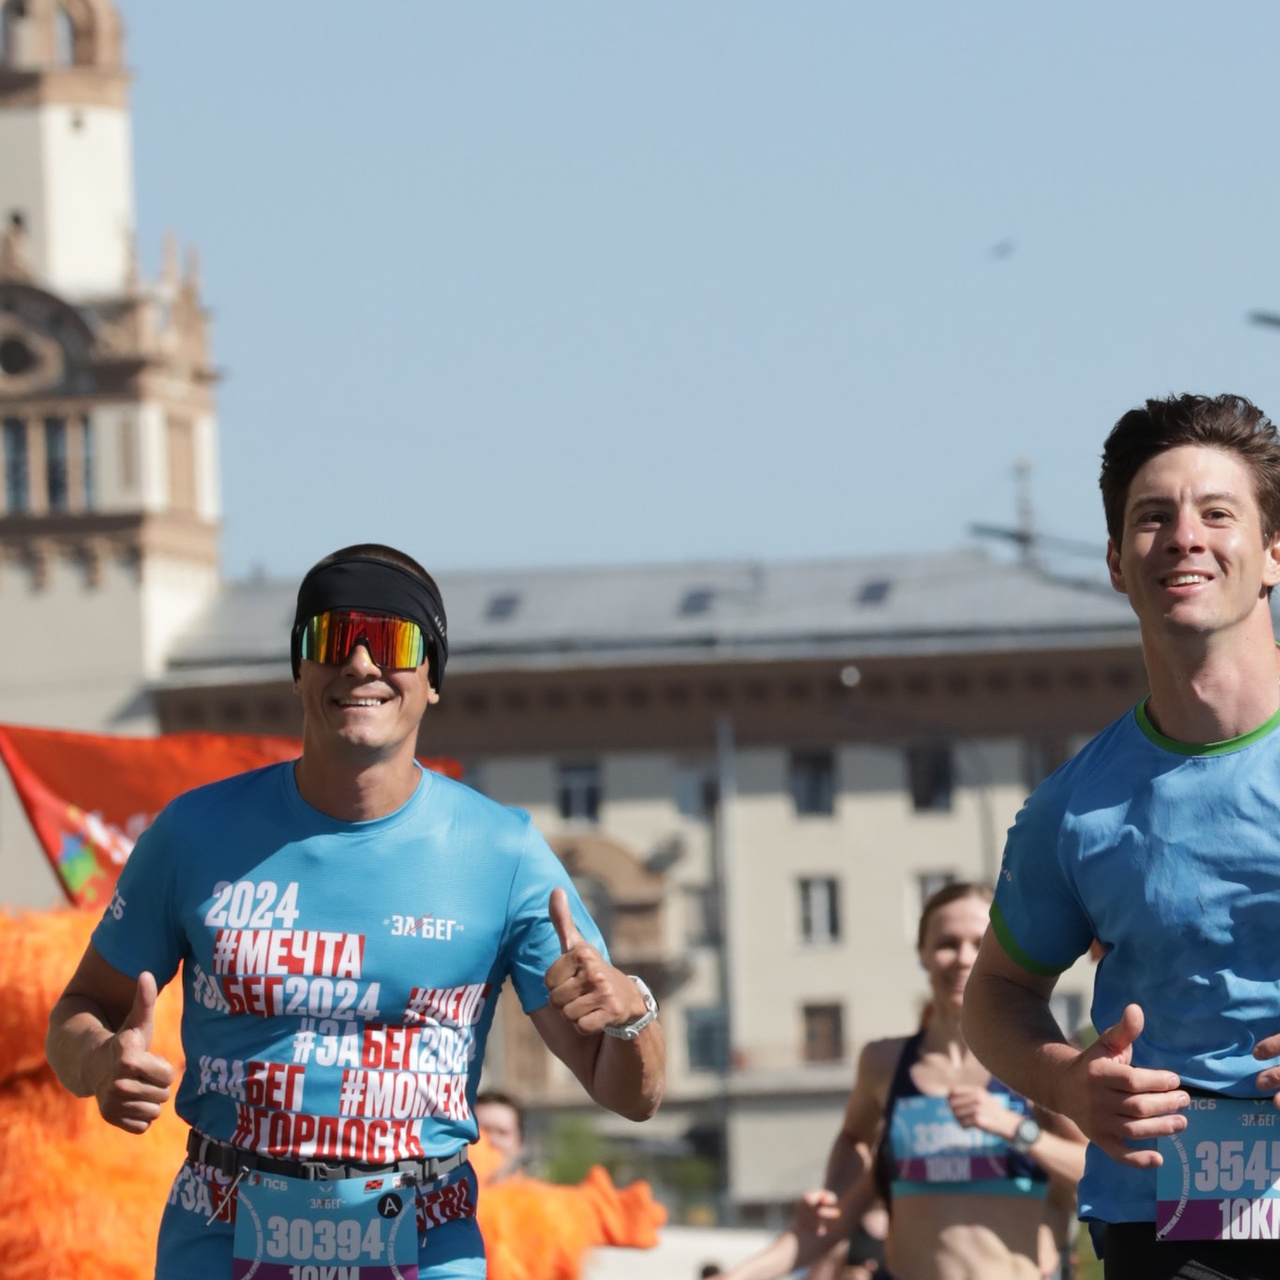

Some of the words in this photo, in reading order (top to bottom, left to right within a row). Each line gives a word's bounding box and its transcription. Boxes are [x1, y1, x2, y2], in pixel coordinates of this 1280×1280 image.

[204, 880, 299, 928] 2024
[213, 929, 365, 979] #МЕЧТА
[193, 965, 382, 1022] #ЗАБЕГ2024
[402, 983, 487, 1027] #ЦЕЛЬ
[293, 1017, 477, 1074] #ЗАБЕГ2024
[198, 1056, 305, 1112] #ЗАБЕГ
[229, 1102, 425, 1165] #ГОРДОСТЬ
[263, 1177, 289, 1192] ПСБ
[266, 1215, 385, 1261] 30394
